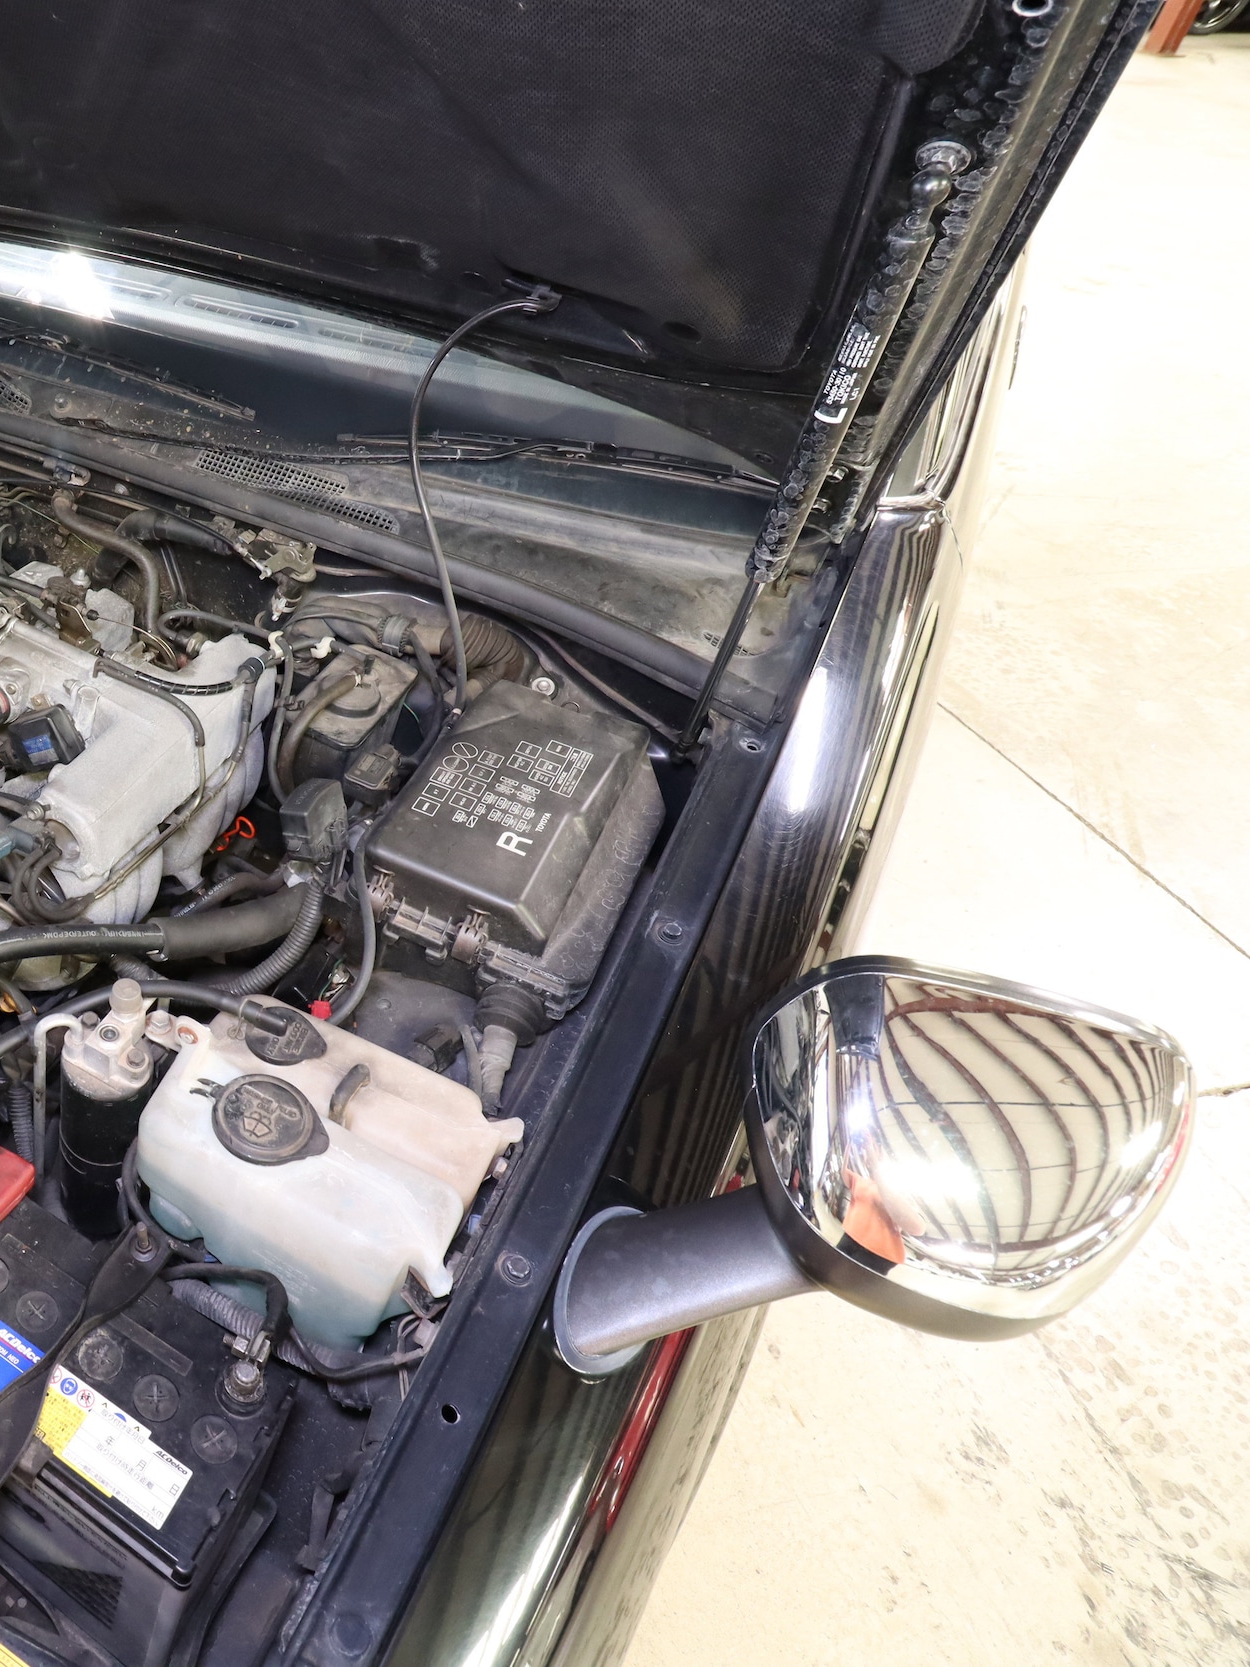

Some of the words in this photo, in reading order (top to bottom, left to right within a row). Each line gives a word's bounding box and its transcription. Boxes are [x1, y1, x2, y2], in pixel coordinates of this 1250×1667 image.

[823, 369, 838, 394] TOYOTA
[834, 374, 852, 401] TOKICO
[814, 408, 848, 424] L
[535, 812, 551, 832] TOYOTA
[496, 831, 533, 857] R
[7, 1353, 20, 1365] NEO
[105, 1435, 115, 1446] 年
[135, 1459, 147, 1472] 月
[169, 1483, 180, 1496] 日
[153, 1450, 188, 1475] ACDelco
[151, 1506, 164, 1519] km
